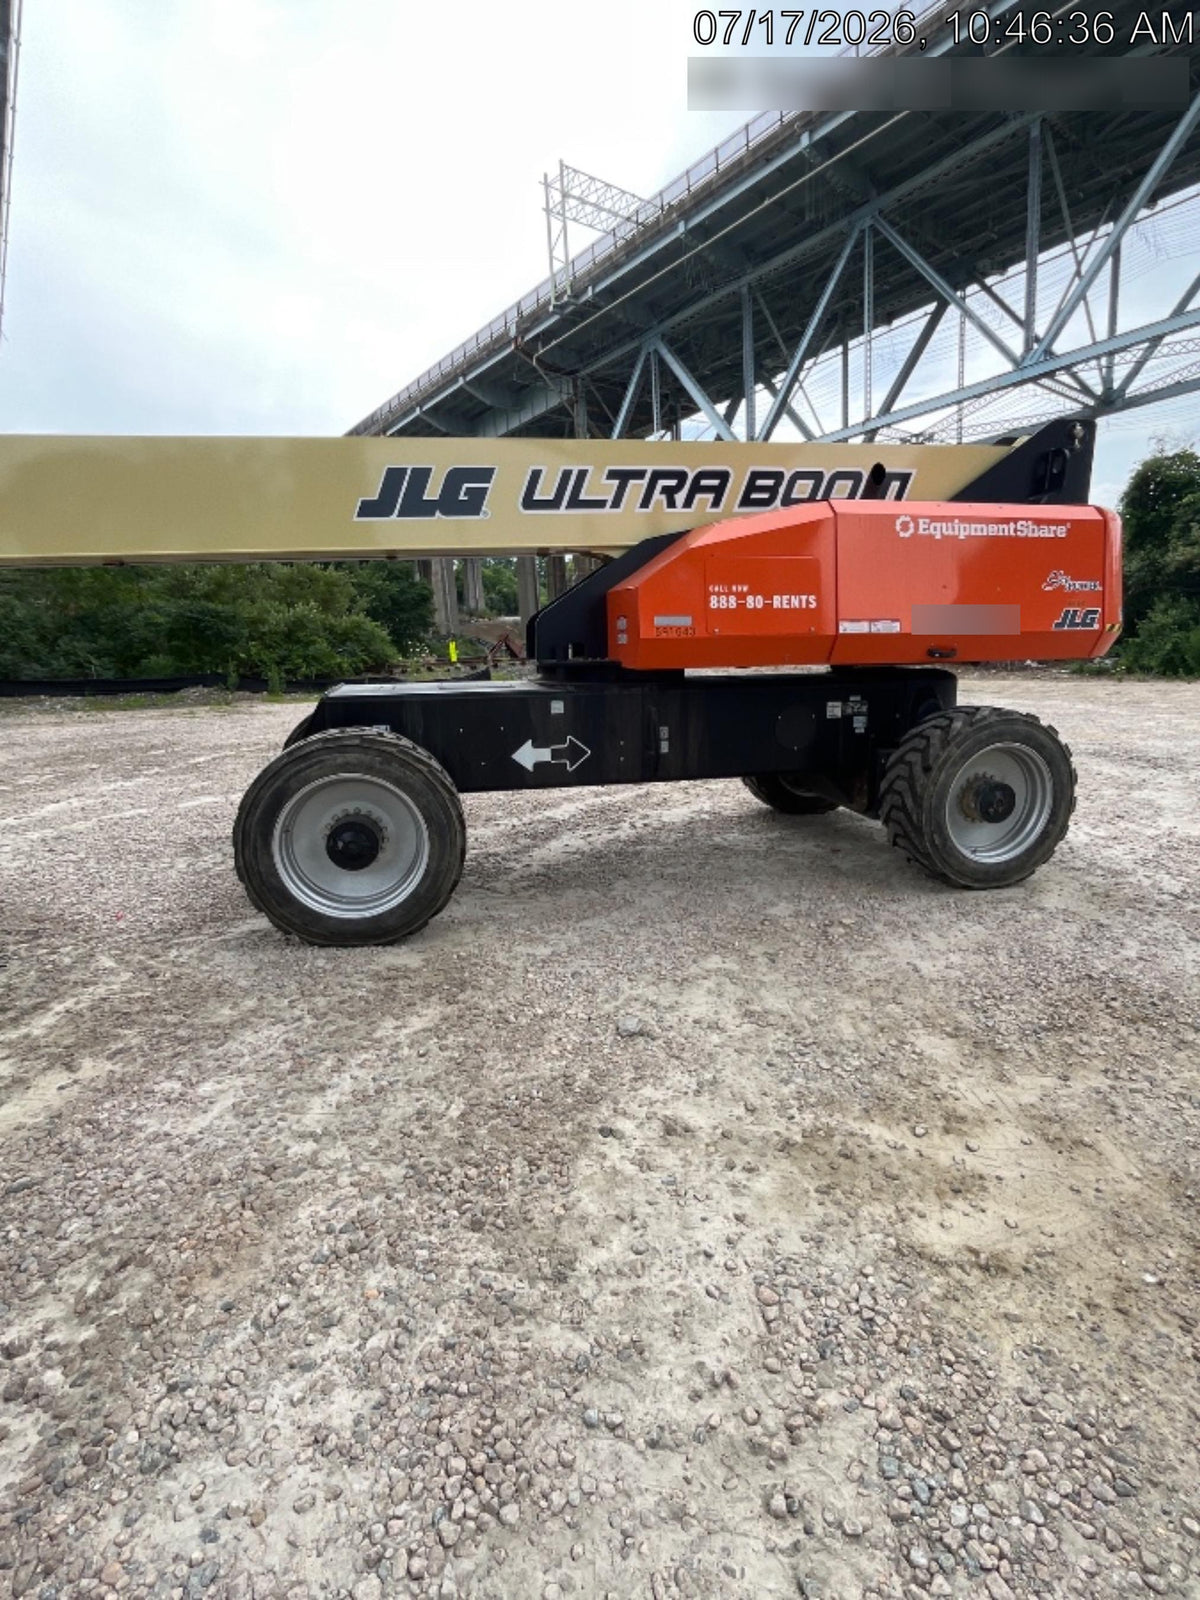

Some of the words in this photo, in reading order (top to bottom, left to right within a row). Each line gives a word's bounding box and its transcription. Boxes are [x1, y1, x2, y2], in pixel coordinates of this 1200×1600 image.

[354, 465, 498, 521] JLG
[518, 465, 734, 515] ULTRA
[916, 517, 1070, 540] EquipmentShare
[708, 594, 818, 609] 888-80-RENTS
[1052, 607, 1102, 630] JLG
